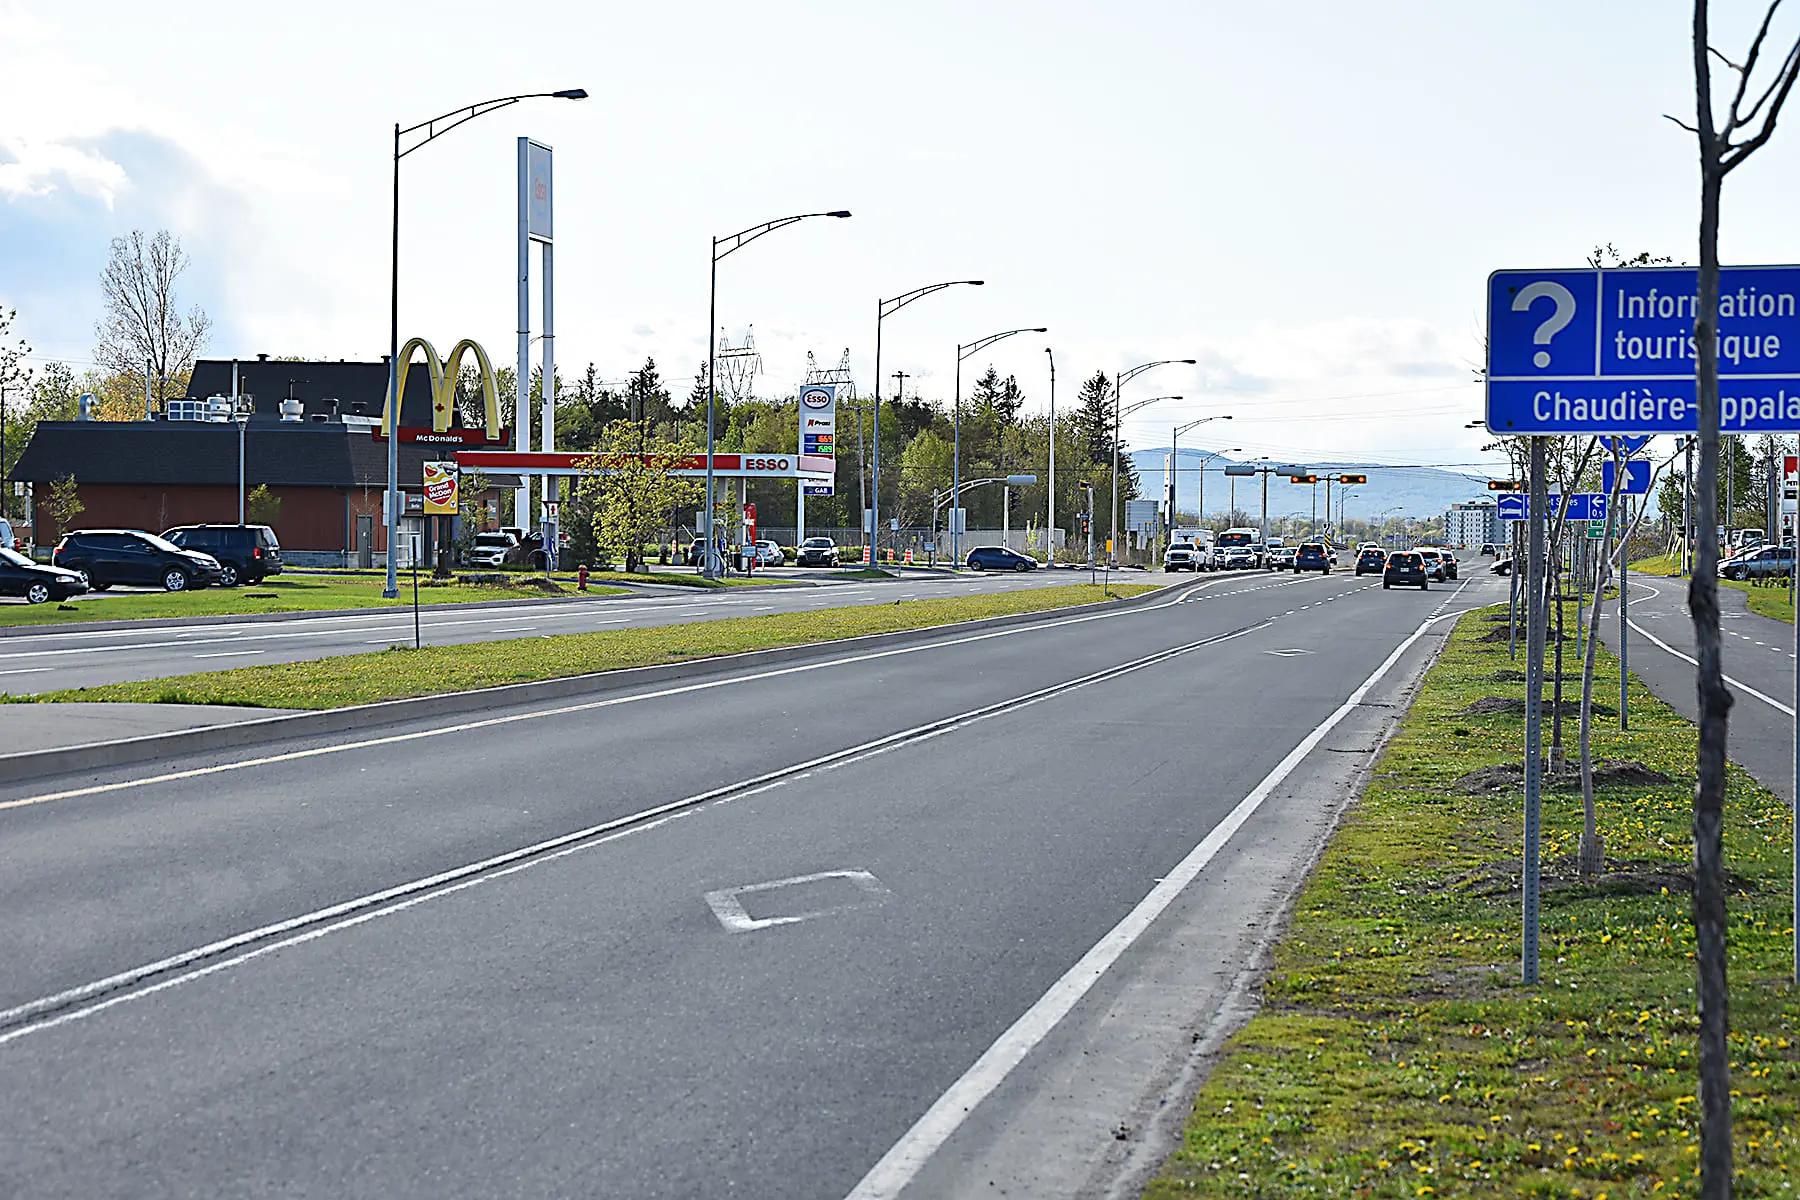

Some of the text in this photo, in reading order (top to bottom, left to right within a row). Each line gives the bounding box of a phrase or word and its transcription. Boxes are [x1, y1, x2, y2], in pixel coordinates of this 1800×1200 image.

[1615, 329, 1780, 365] tourisique
[1533, 389, 1800, 427] Chaudière-ppala
[416, 434, 463, 443] McDonald's
[746, 458, 789, 471] ESSO
[428, 482, 449, 492] Grand
